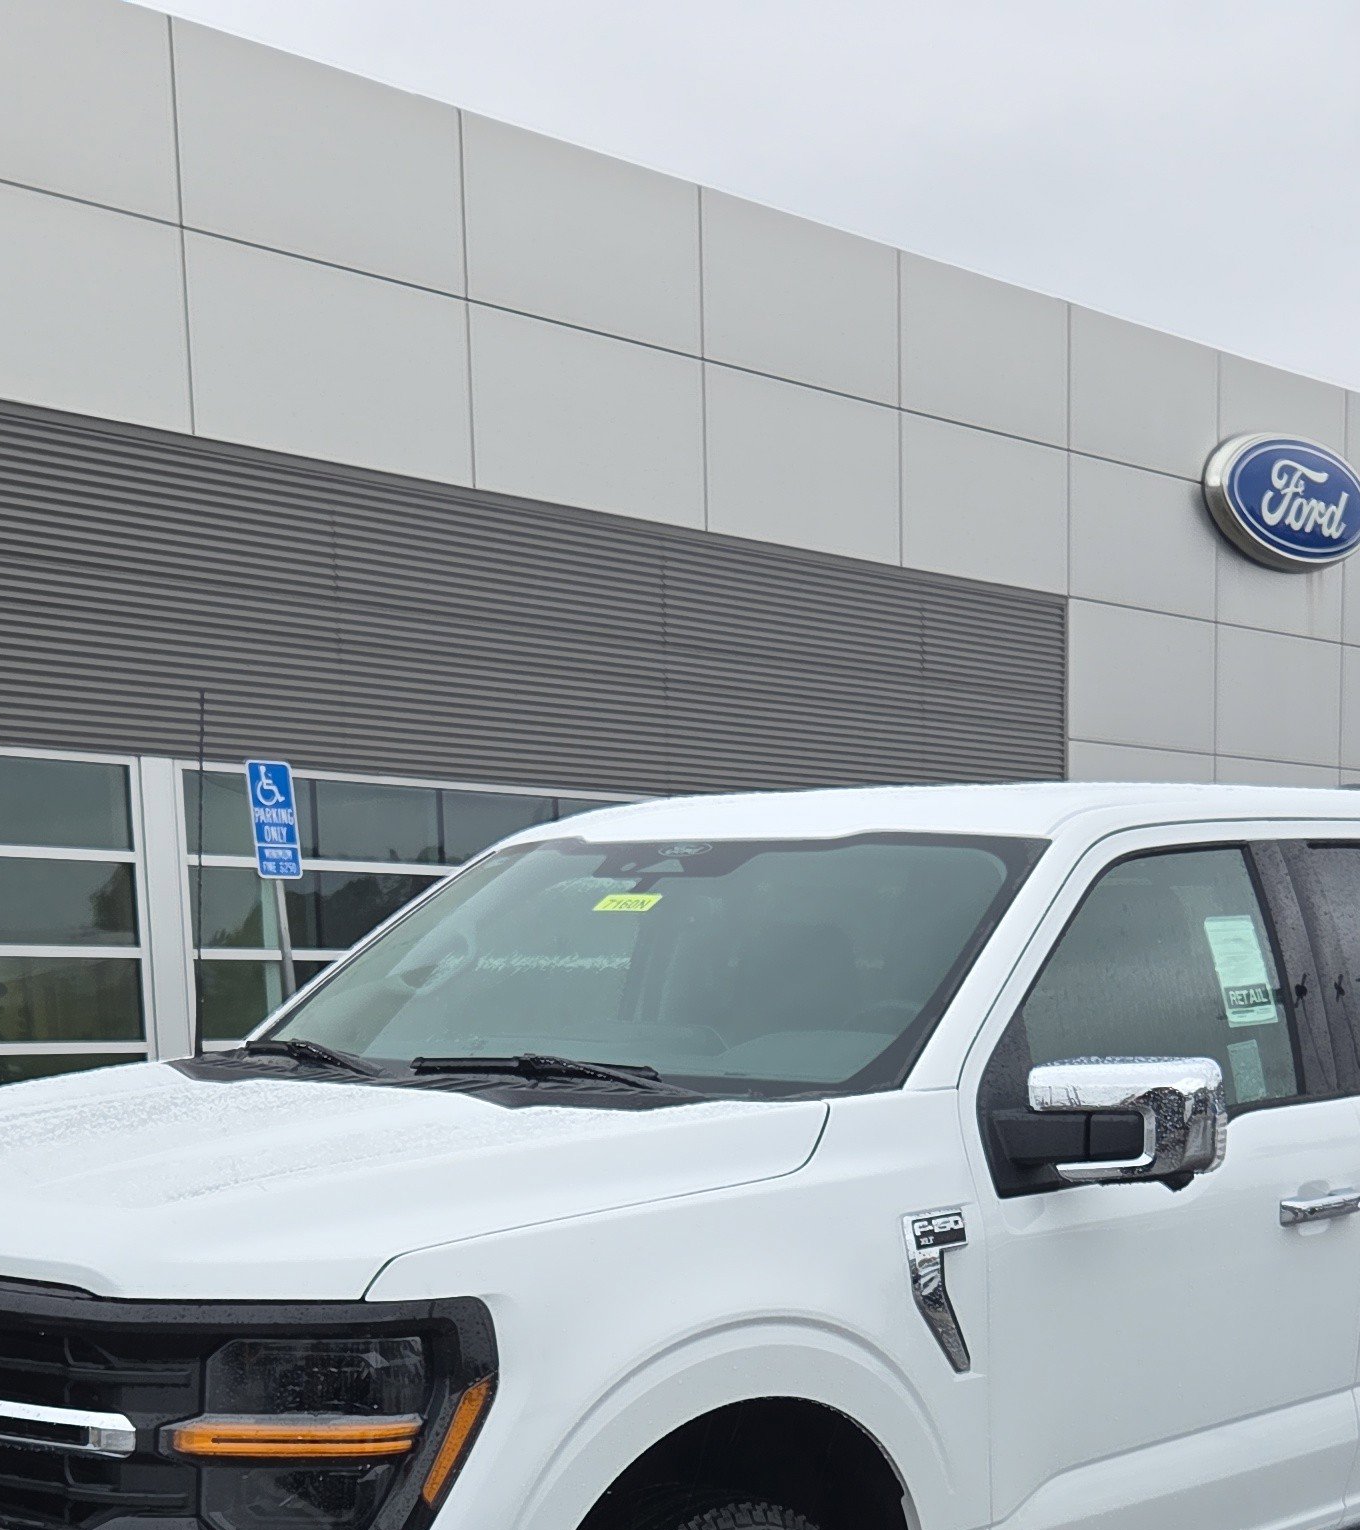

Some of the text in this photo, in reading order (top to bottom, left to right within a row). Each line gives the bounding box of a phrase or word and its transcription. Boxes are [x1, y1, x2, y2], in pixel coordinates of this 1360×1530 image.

[1261, 458, 1348, 540] Ford
[253, 807, 295, 826] PARKING
[264, 825, 288, 843] ONLY
[1228, 988, 1269, 1006] RETAIL
[914, 1215, 965, 1236] F-150
